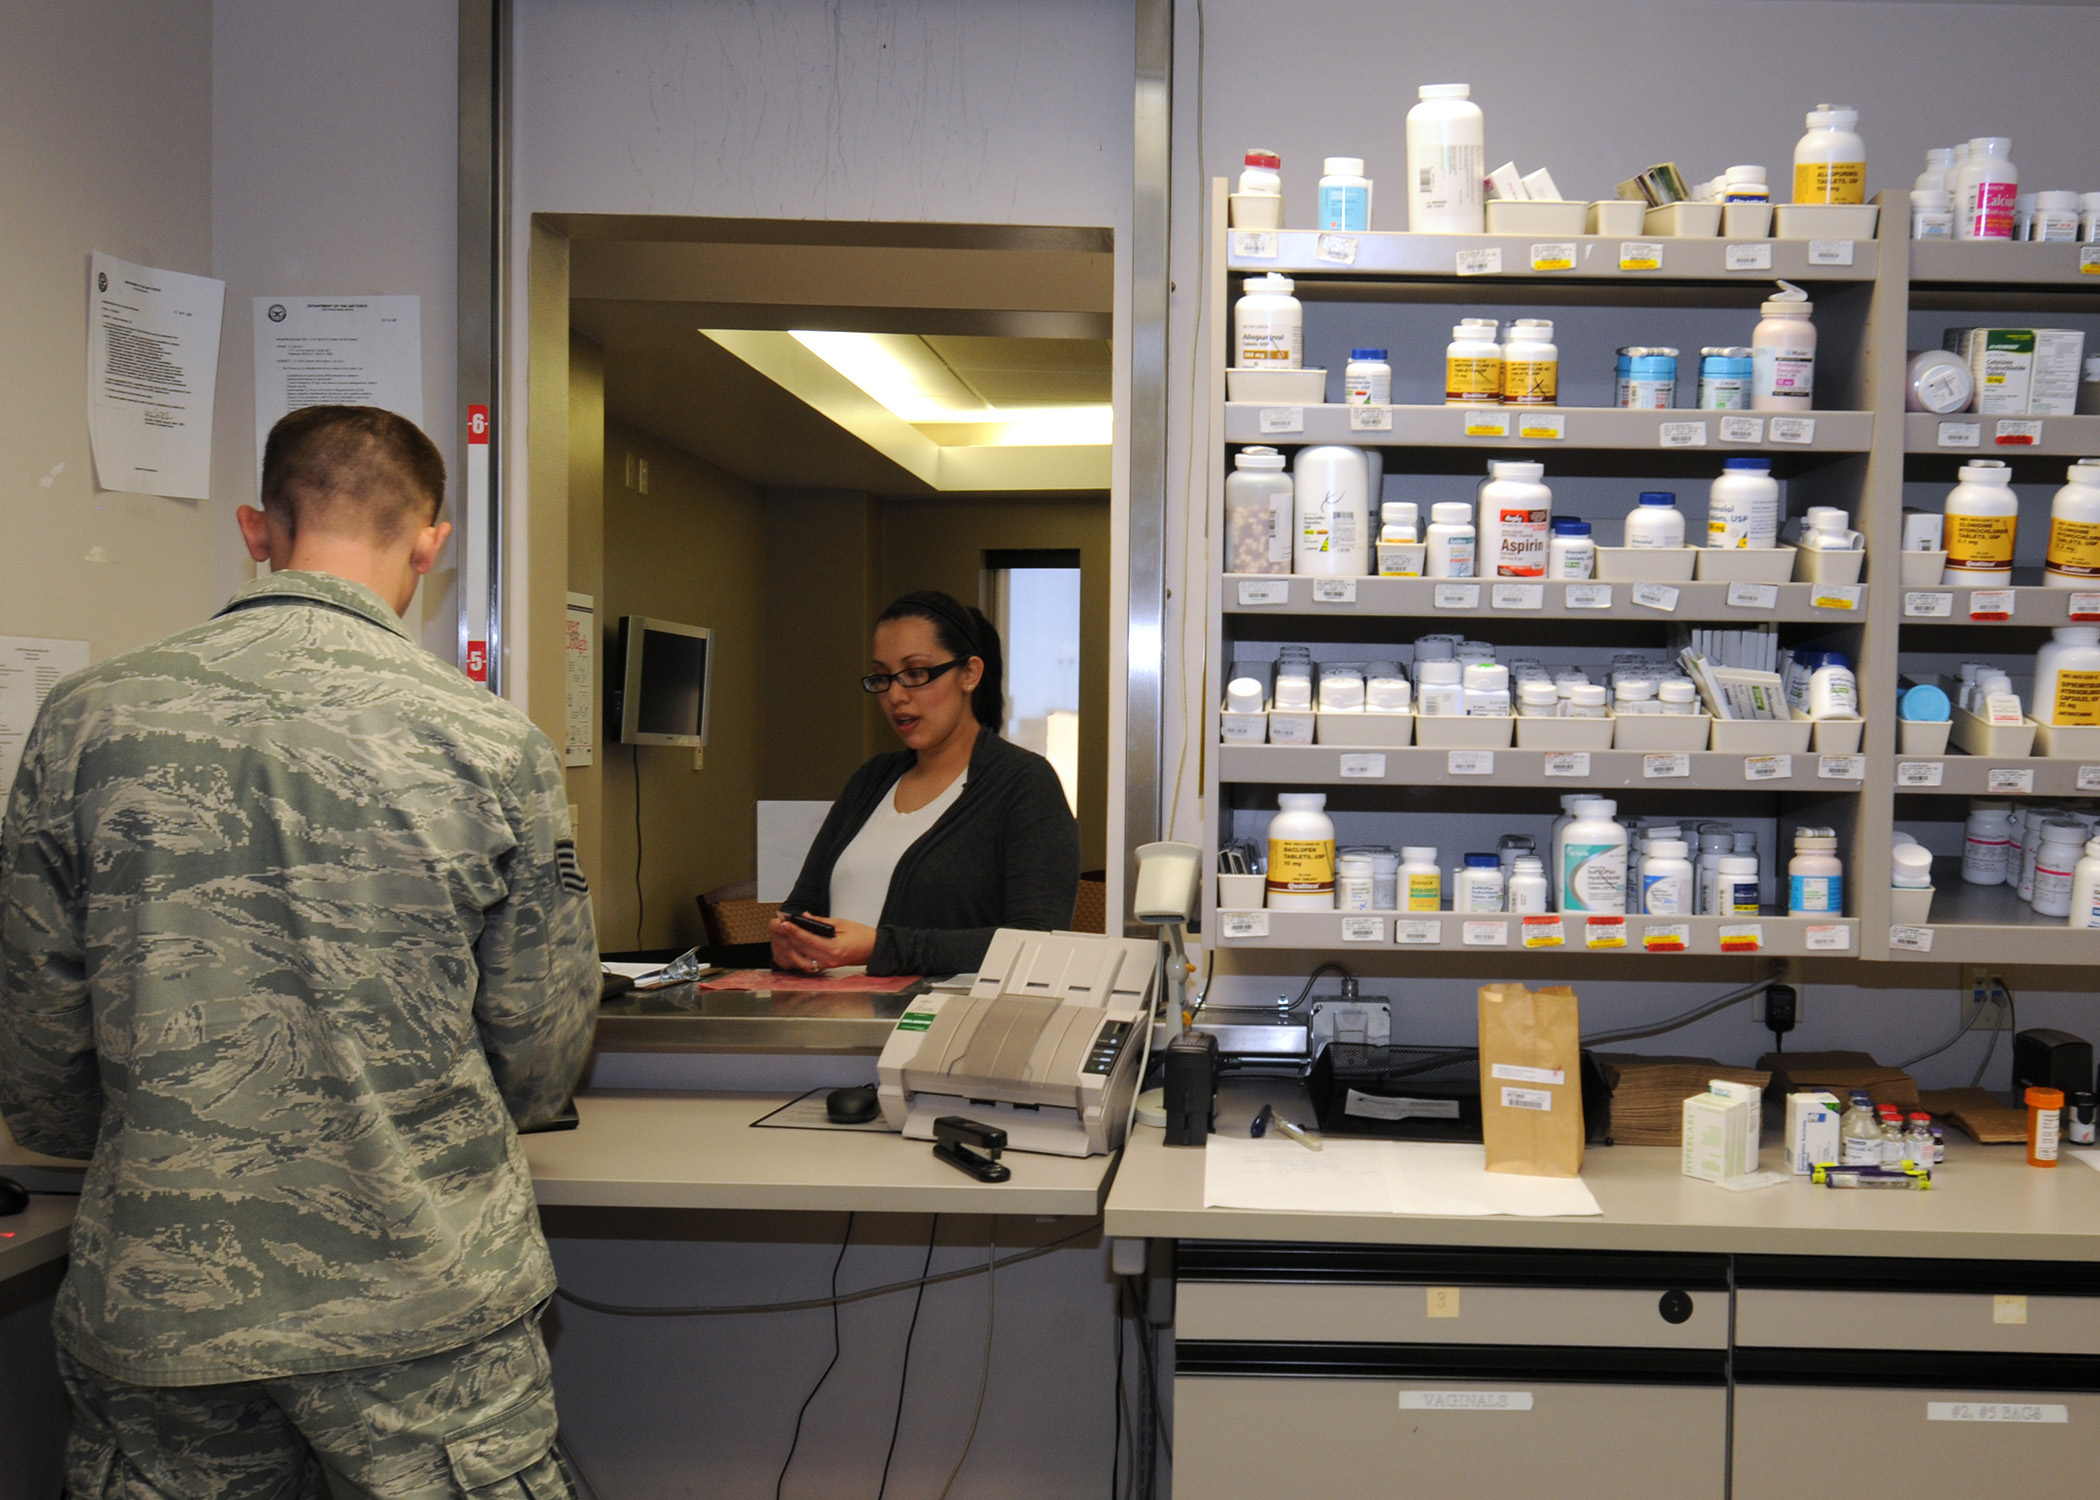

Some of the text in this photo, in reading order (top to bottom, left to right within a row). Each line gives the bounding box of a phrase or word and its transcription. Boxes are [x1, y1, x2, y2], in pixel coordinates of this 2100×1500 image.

[472, 413, 485, 434] 6
[1502, 539, 1544, 554] Aspirin
[470, 651, 482, 671] 5
[1686, 1113, 1696, 1173] HYPERCARE
[1423, 1394, 1508, 1408] VAGINALS
[2002, 1406, 2041, 1420] BAGS
